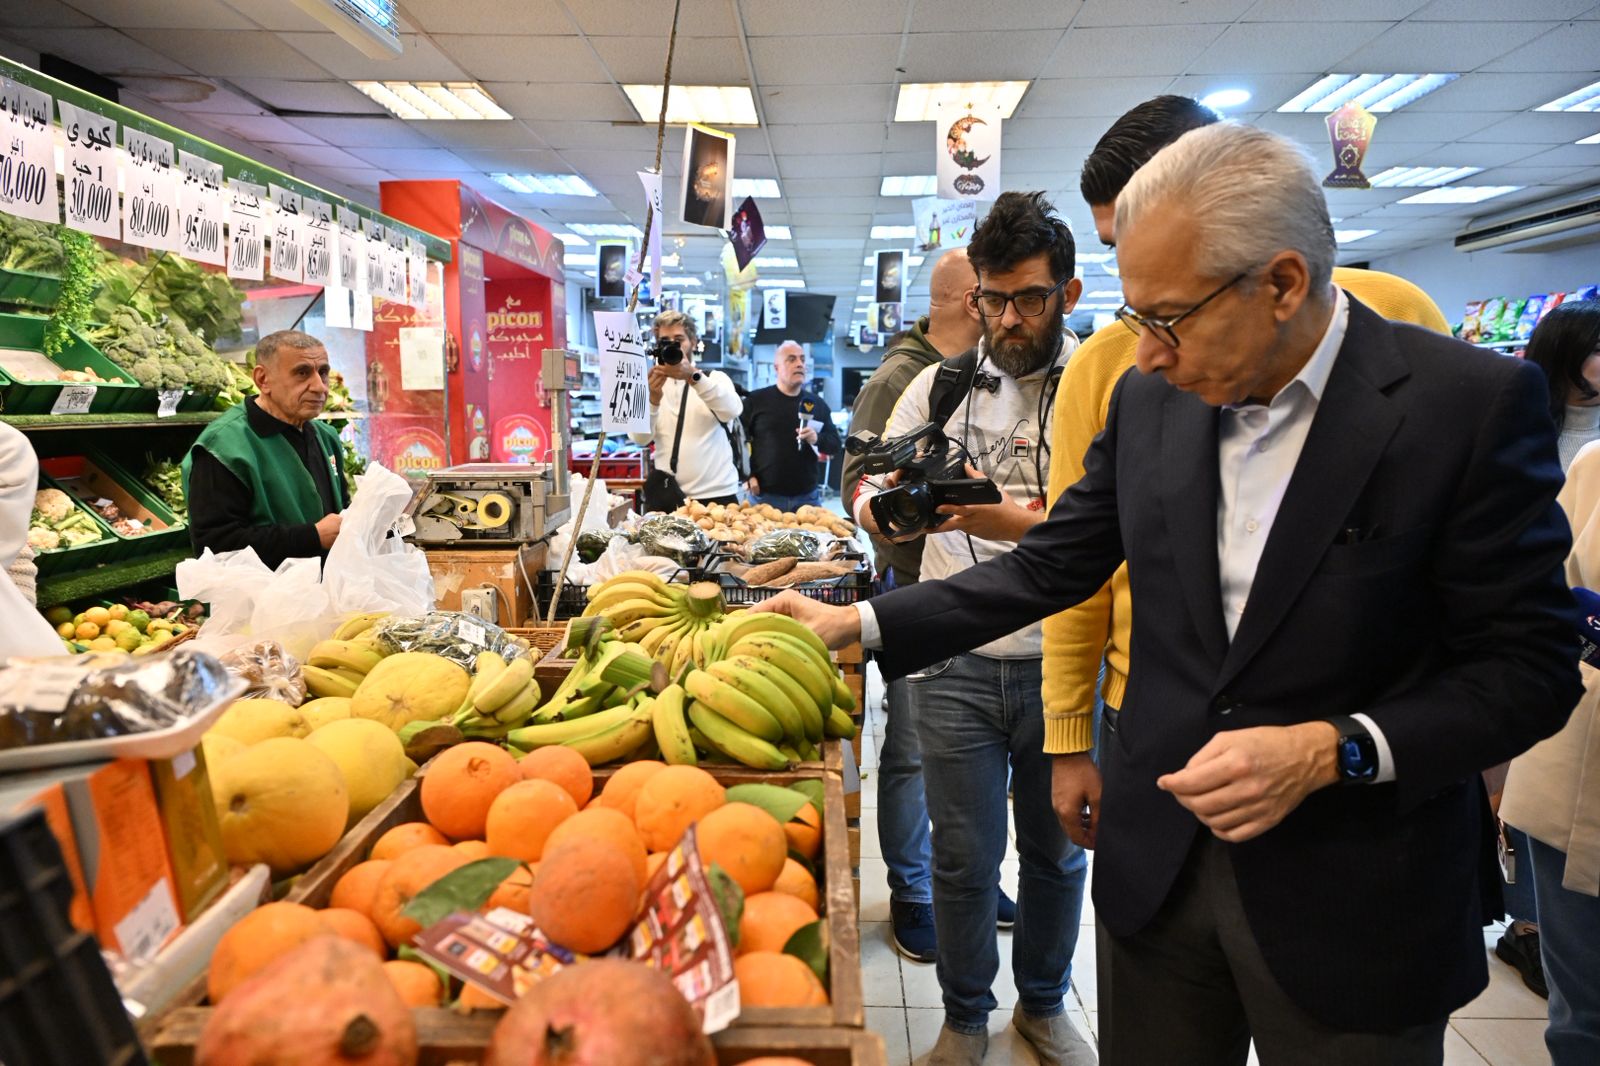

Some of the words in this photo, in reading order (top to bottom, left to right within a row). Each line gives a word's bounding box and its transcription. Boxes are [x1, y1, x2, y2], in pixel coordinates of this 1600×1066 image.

[70, 177, 112, 223] 30.000
[276, 193, 299, 217] خيار
[129, 195, 170, 238] 80.000
[309, 206, 330, 228] جزر
[184, 214, 219, 253] 95.000
[233, 236, 261, 270] 70.000
[307, 248, 331, 278] 85.000
[487, 307, 542, 334] picon
[609, 380, 647, 419] 475.000
[503, 434, 541, 452] picon
[393, 453, 442, 471] picon
